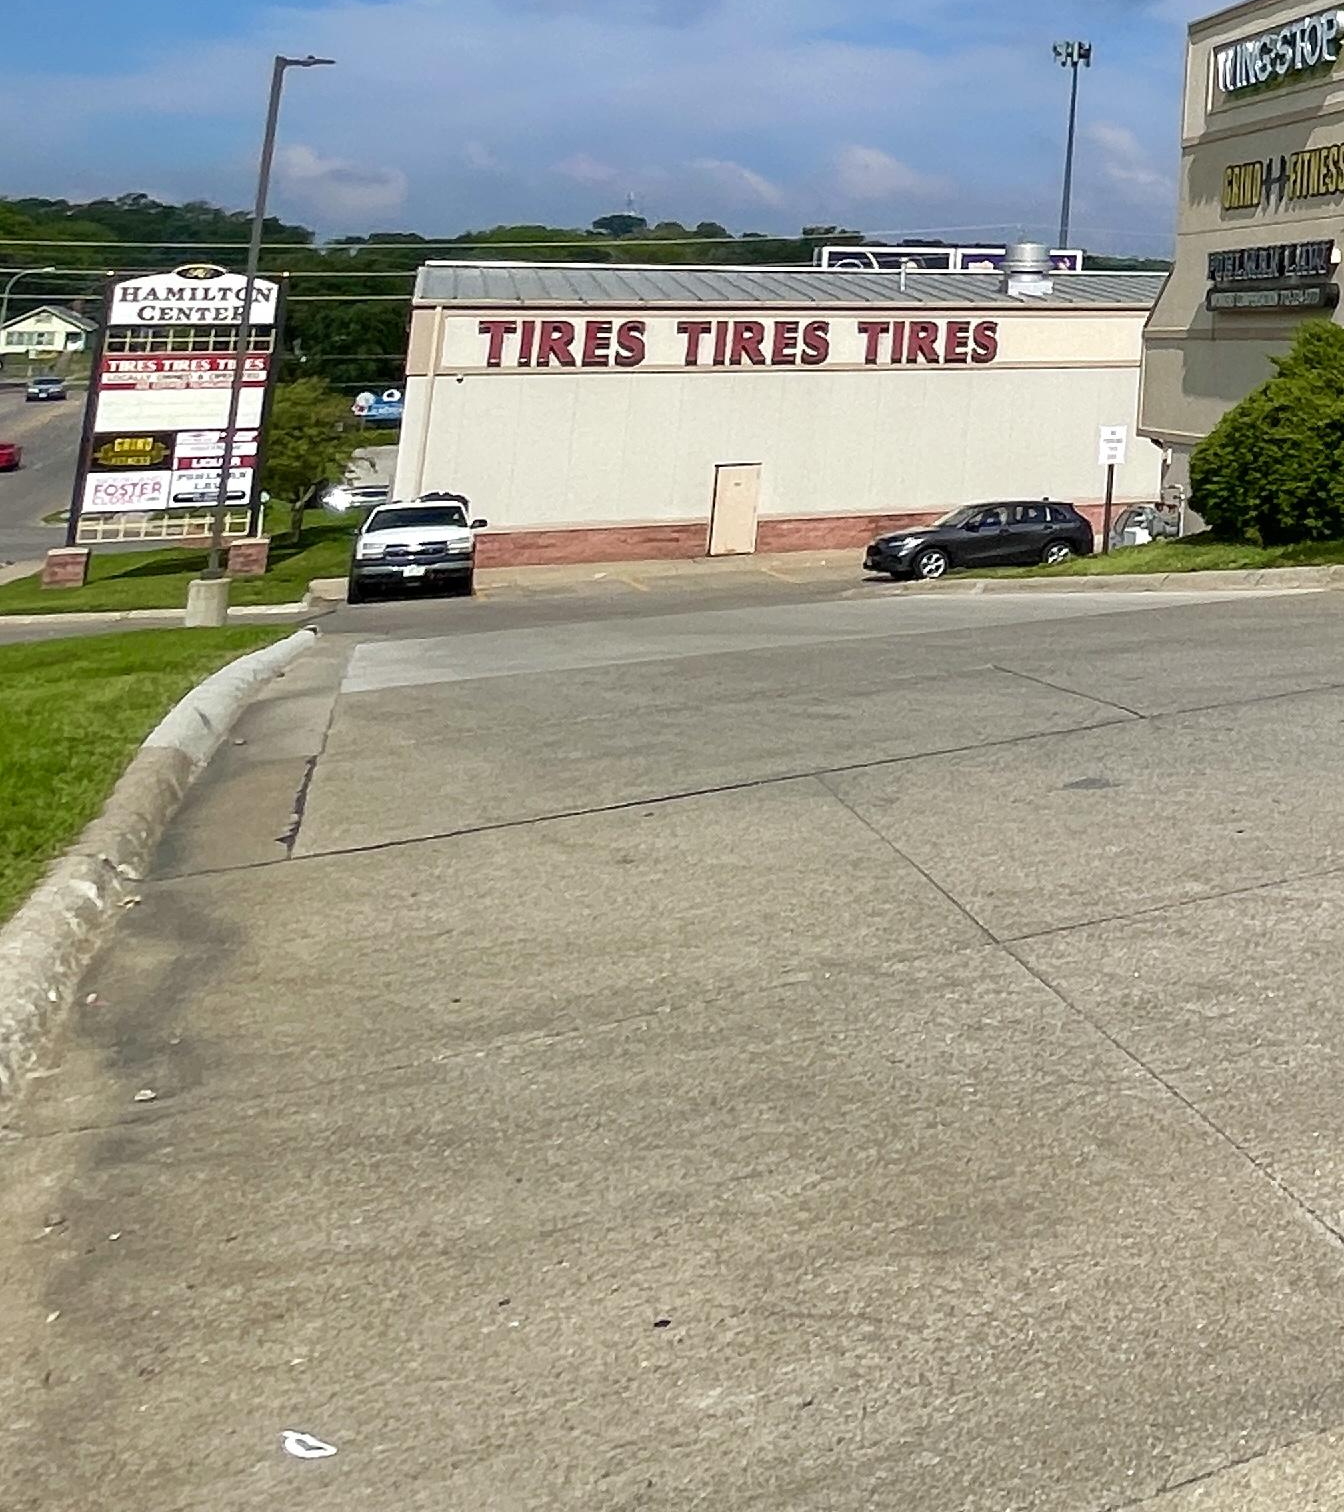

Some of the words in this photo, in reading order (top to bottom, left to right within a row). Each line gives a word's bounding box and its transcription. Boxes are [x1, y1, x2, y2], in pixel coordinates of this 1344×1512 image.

[118, 286, 274, 303] HAMILTON
[478, 320, 646, 368] TIRES
[676, 319, 831, 367] TIRES
[856, 319, 1000, 365] TIRES
[107, 359, 158, 373] TIRES
[162, 359, 212, 373] TIRES
[94, 481, 162, 497] FOSTER
